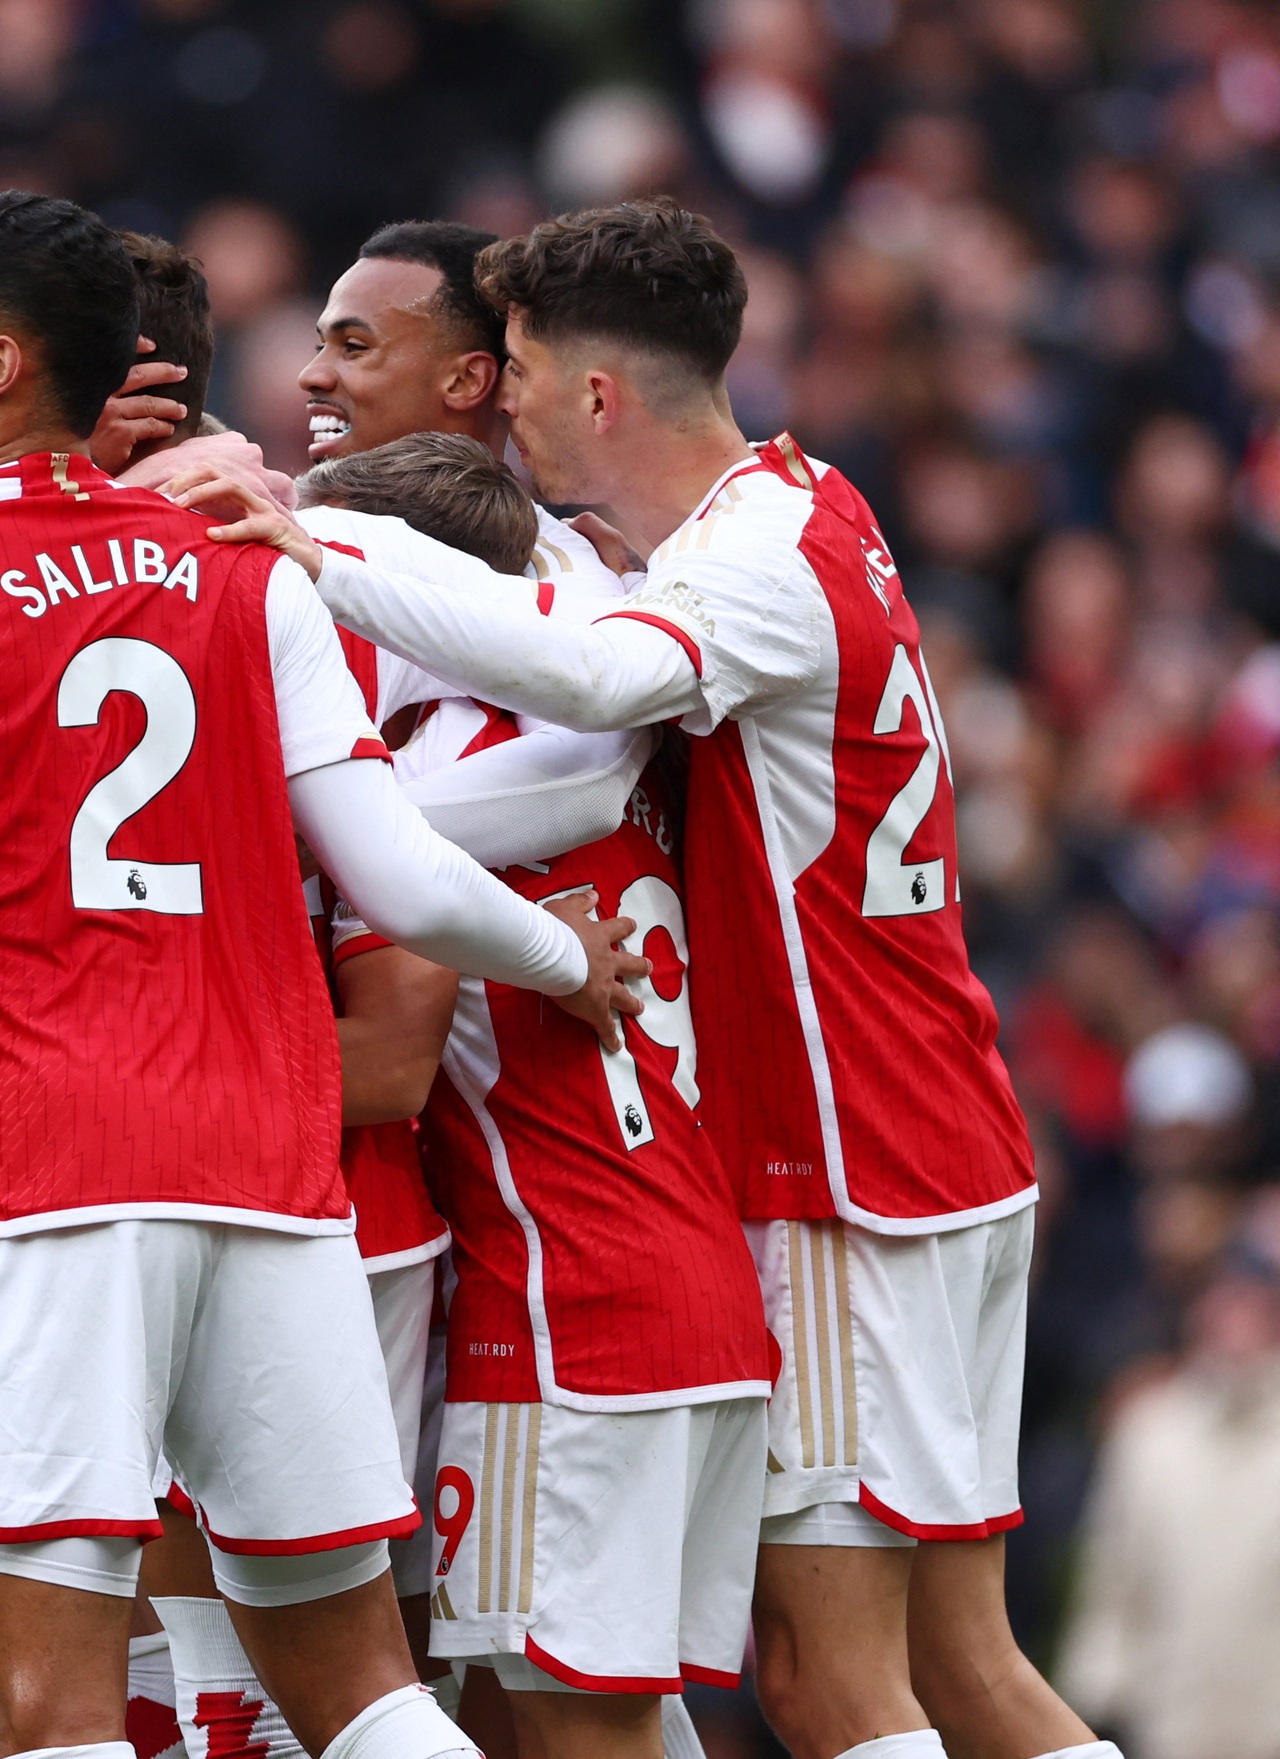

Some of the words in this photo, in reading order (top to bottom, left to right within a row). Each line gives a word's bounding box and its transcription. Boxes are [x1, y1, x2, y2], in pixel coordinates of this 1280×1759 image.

[52, 454, 69, 463] AFC
[0, 538, 200, 618] SALIBA
[56, 635, 206, 916] 2
[766, 1162, 813, 1176] HEAT.RDY
[468, 1342, 515, 1357] HEAT.RDY
[433, 1465, 475, 1576] 9
